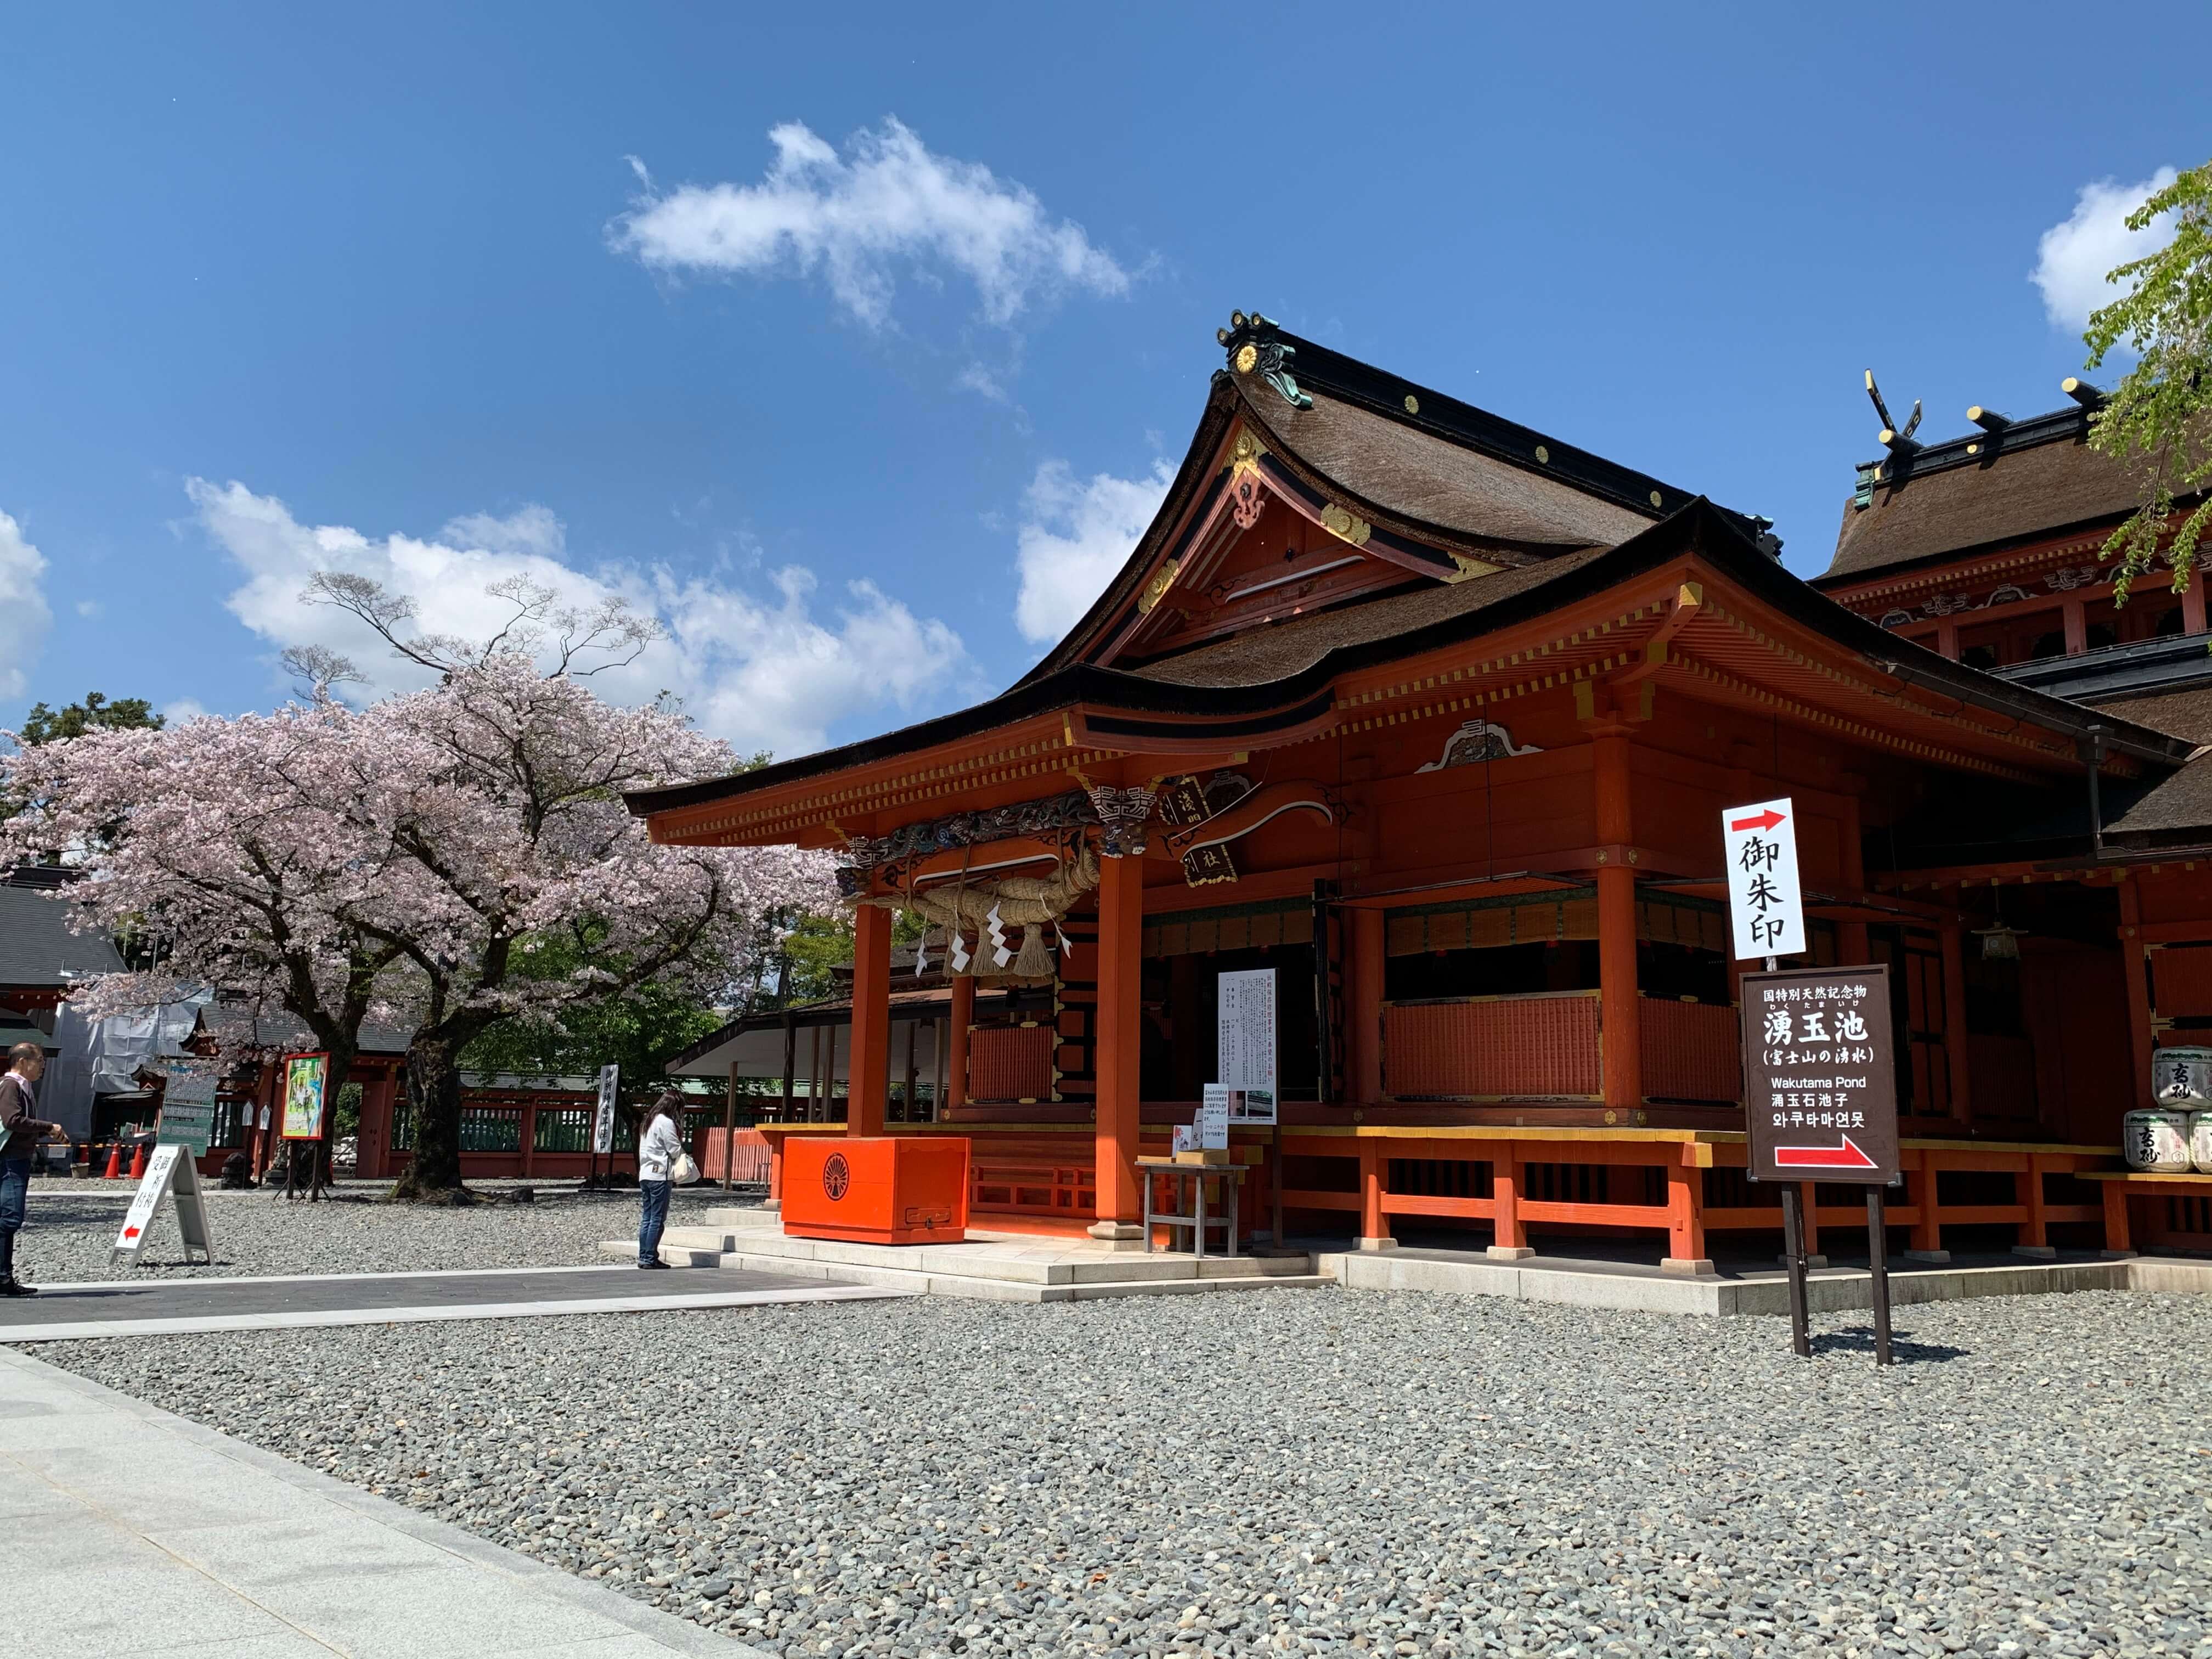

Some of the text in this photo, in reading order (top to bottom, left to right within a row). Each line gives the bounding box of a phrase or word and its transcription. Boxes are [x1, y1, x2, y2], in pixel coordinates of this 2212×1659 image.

[1203, 850, 1221, 868] 社
[1739, 836, 1785, 949] 御朱印
[1763, 985, 1867, 1002] 国特別天然記念物
[1763, 1009, 1869, 1045] 湧玉池
[1763, 1046, 1874, 1065] (富士山の湧水)
[1771, 1076, 1866, 1089] Wakutama Pond
[1771, 1093, 1848, 1108] 涌玉石池子
[1773, 1111, 1865, 1128] 와쿠타마연못
